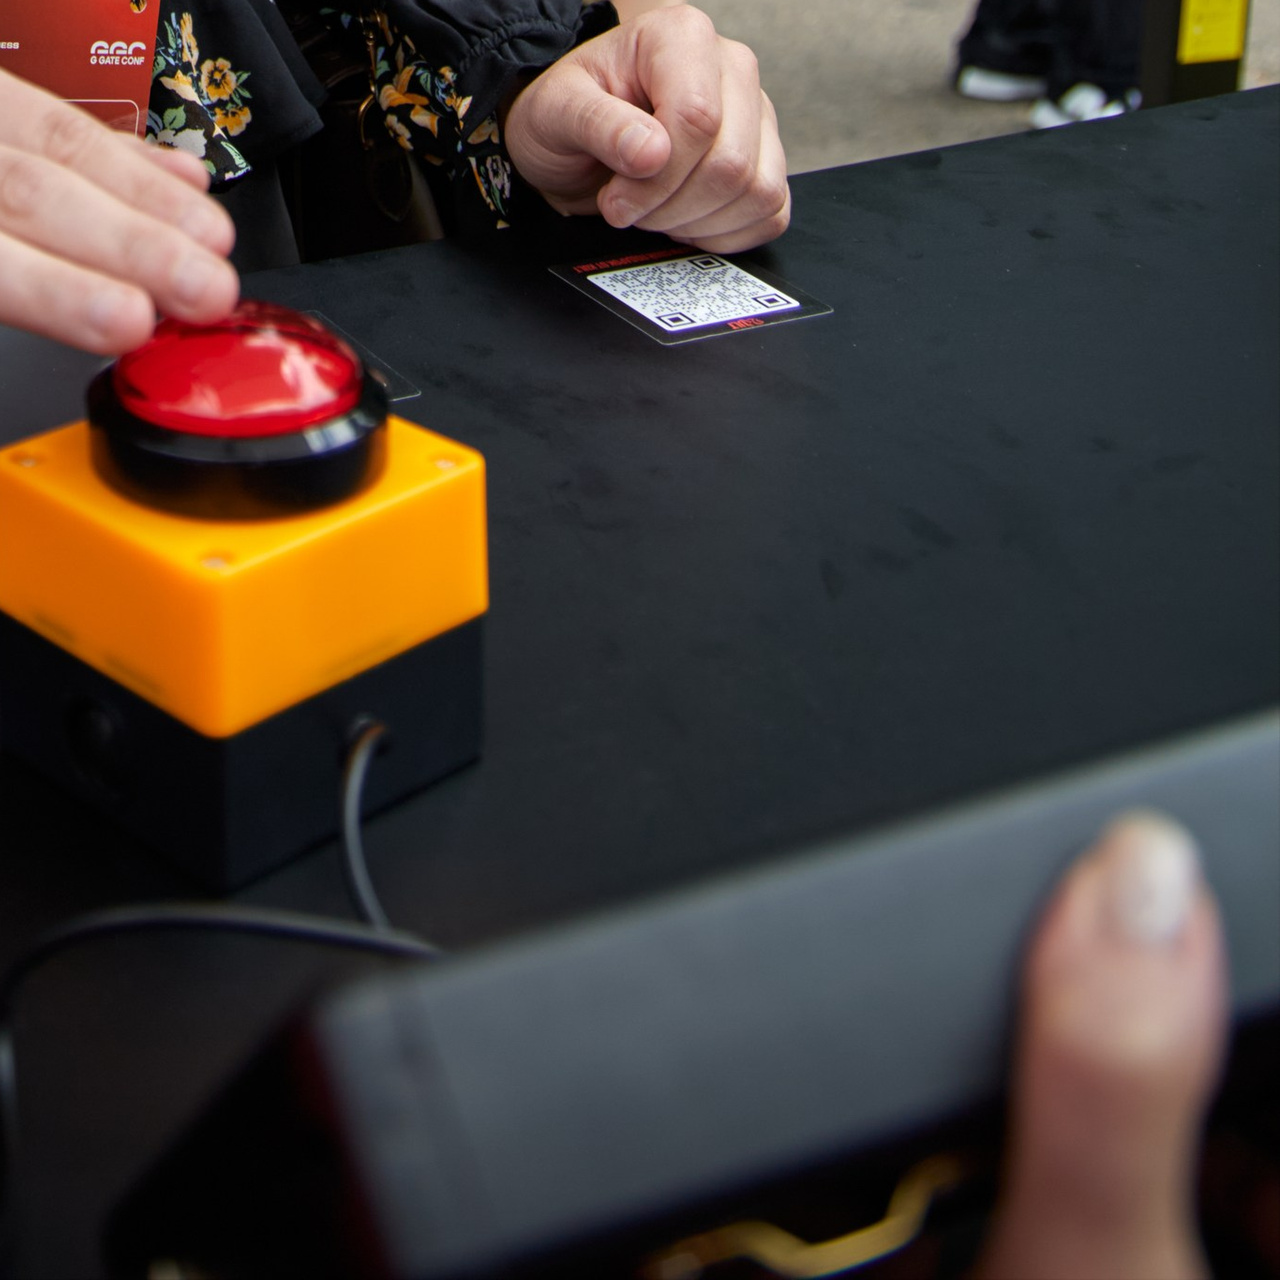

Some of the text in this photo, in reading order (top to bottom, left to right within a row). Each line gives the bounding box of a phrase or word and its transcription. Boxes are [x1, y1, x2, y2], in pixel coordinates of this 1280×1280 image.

[90, 55, 145, 65] G GATE CONF
